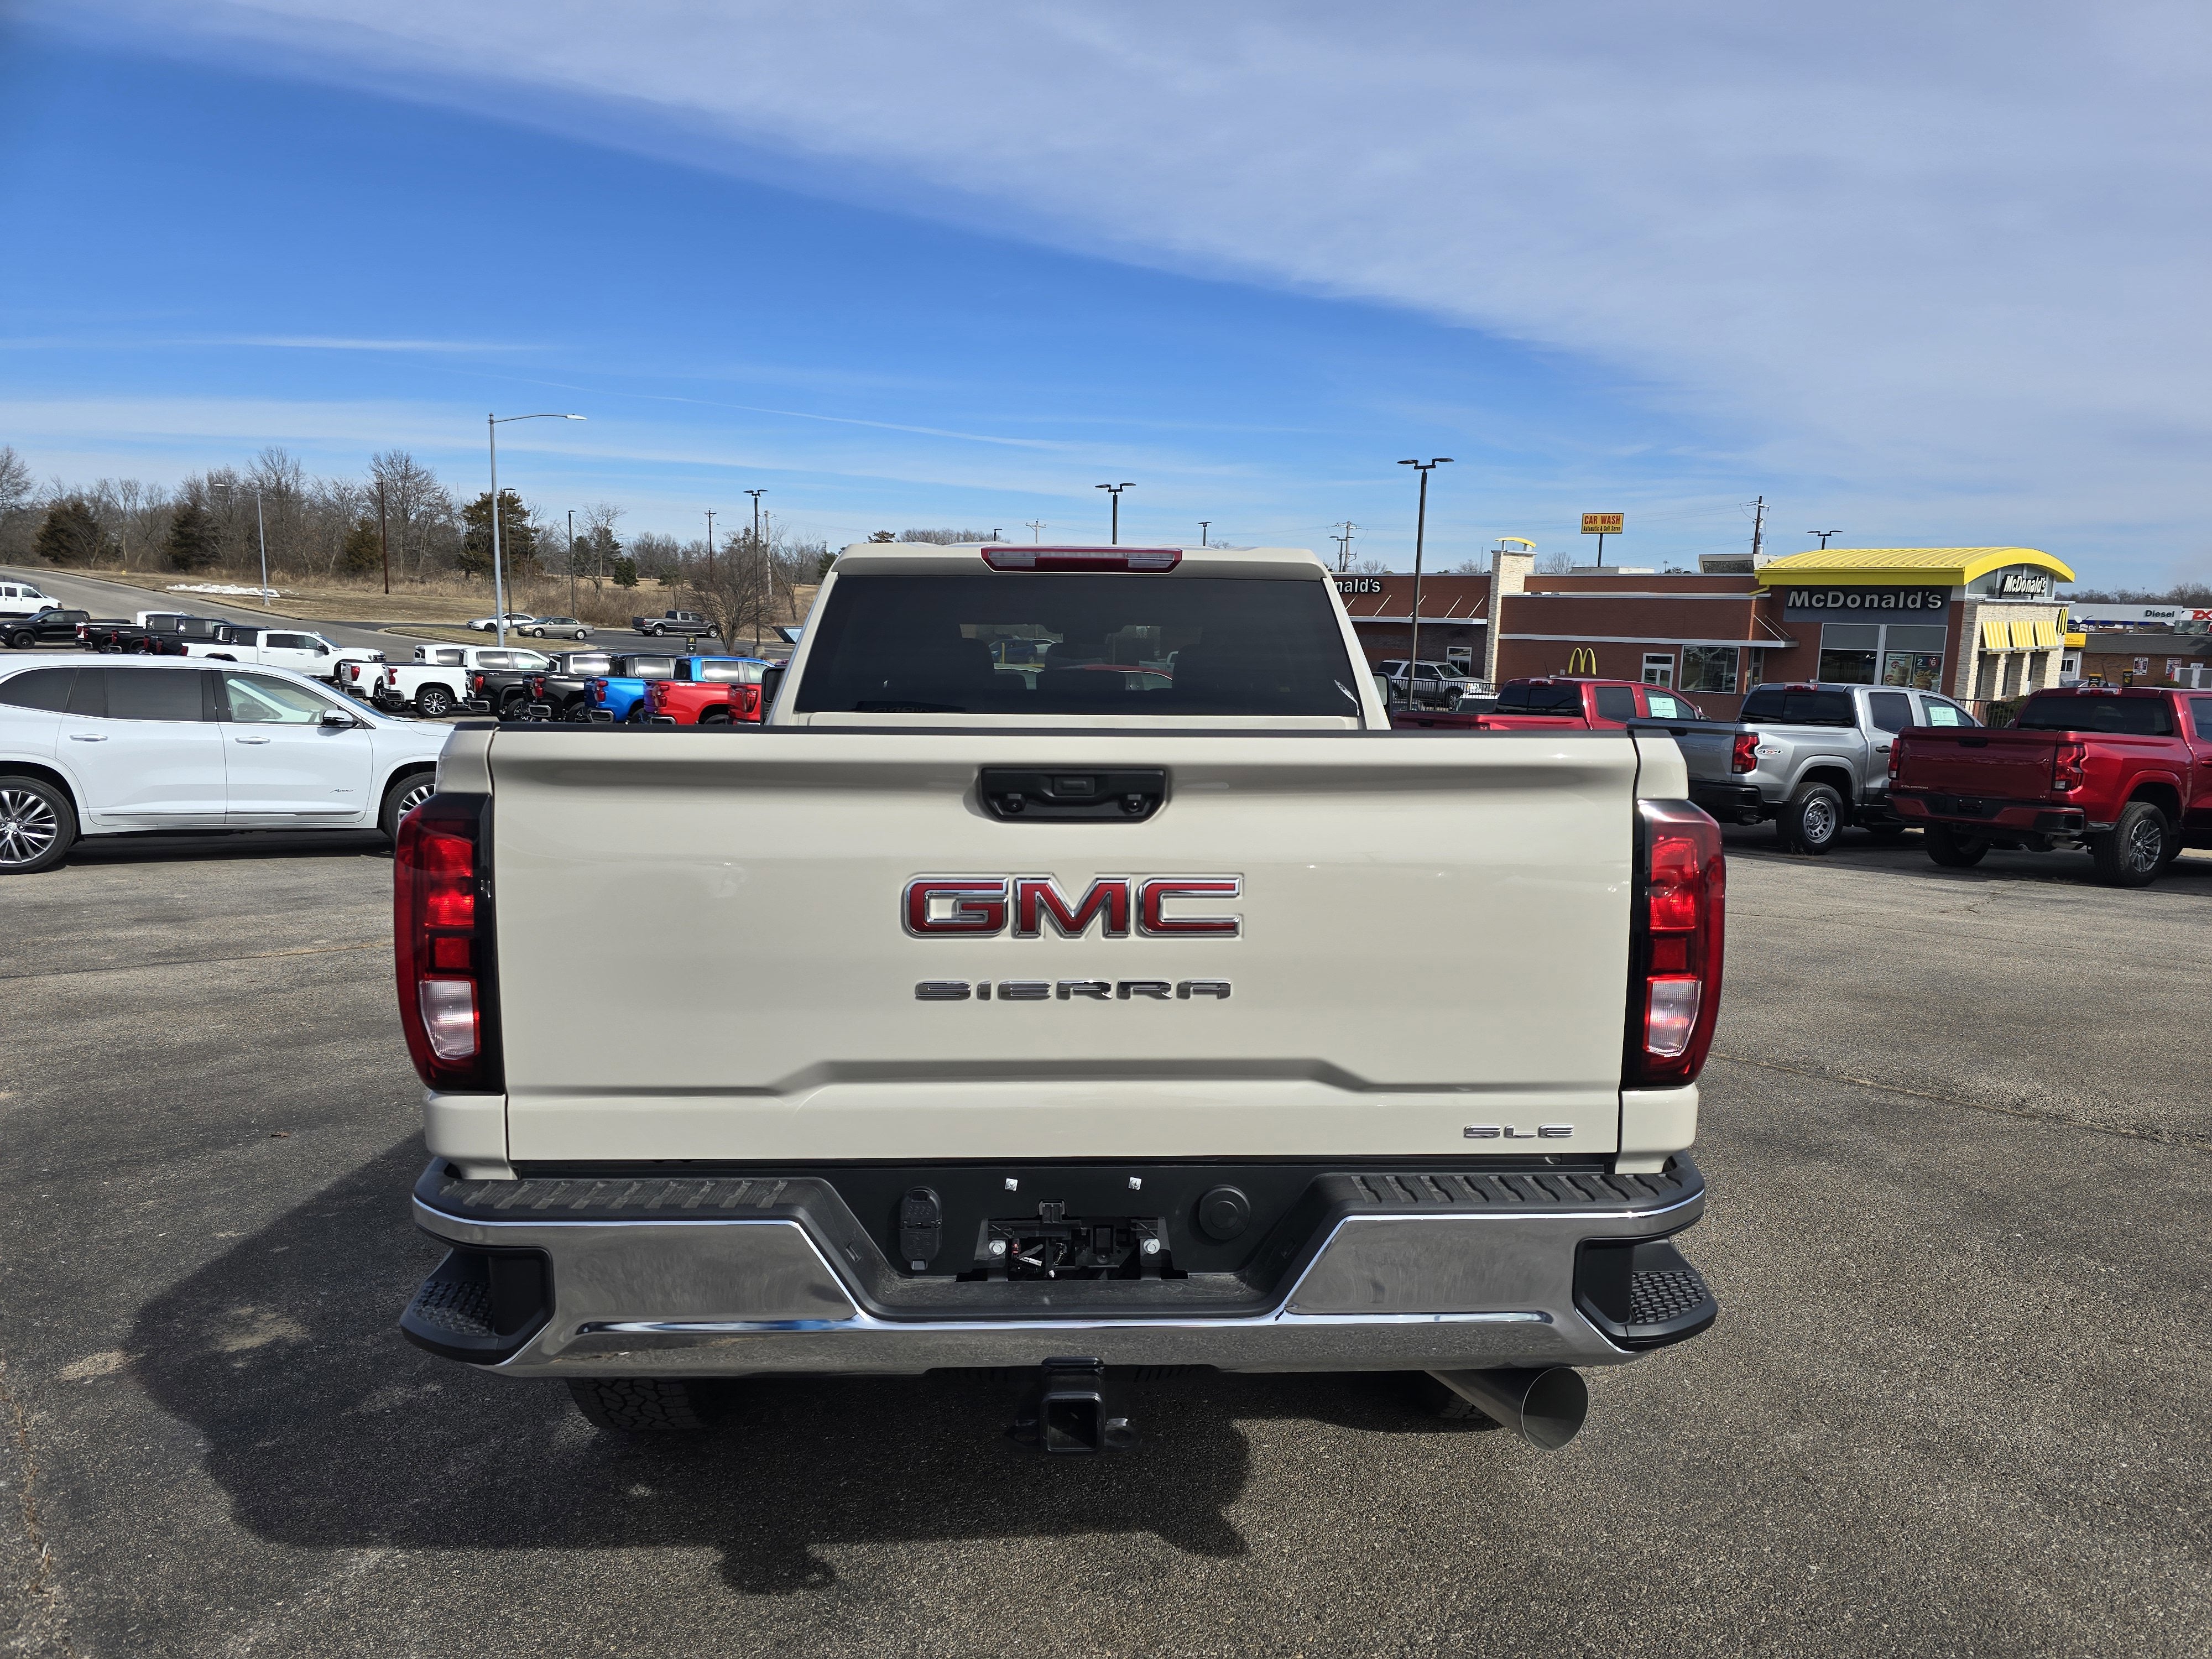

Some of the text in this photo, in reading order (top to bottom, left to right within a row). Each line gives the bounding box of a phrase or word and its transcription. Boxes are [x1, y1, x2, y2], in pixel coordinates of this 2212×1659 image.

[1584, 515, 1621, 525] CAR WASH
[1335, 578, 1380, 593] nald's
[2003, 575, 2047, 593] McDonald's
[1787, 590, 1942, 609] McDonald's
[2145, 609, 2175, 618] Diesel
[902, 876, 1242, 939] GMC
[915, 979, 1233, 1000] SIERRA
[1463, 1124, 1574, 1139] SLE
